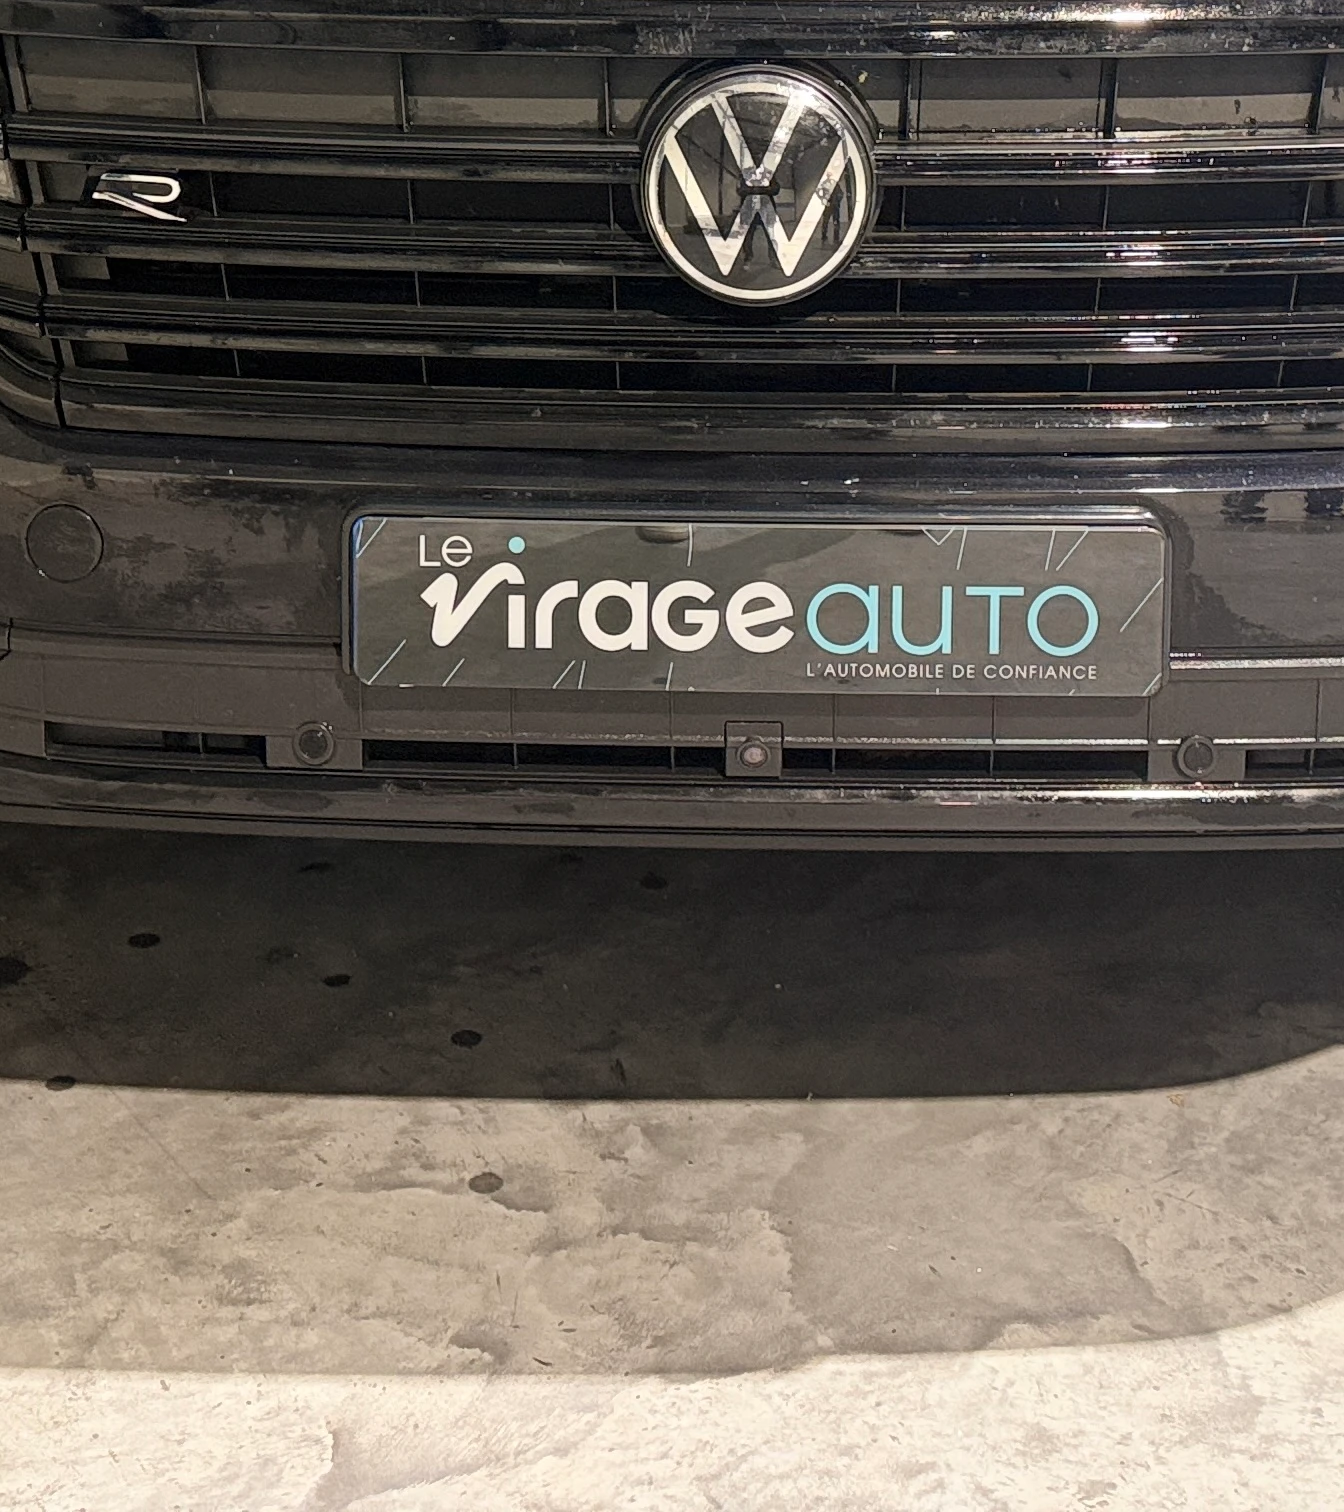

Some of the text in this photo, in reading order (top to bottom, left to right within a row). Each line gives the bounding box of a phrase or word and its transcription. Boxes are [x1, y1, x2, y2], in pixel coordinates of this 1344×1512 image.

[805, 662, 1098, 681] L'AUTOMOBILE DE CONFIANCE
